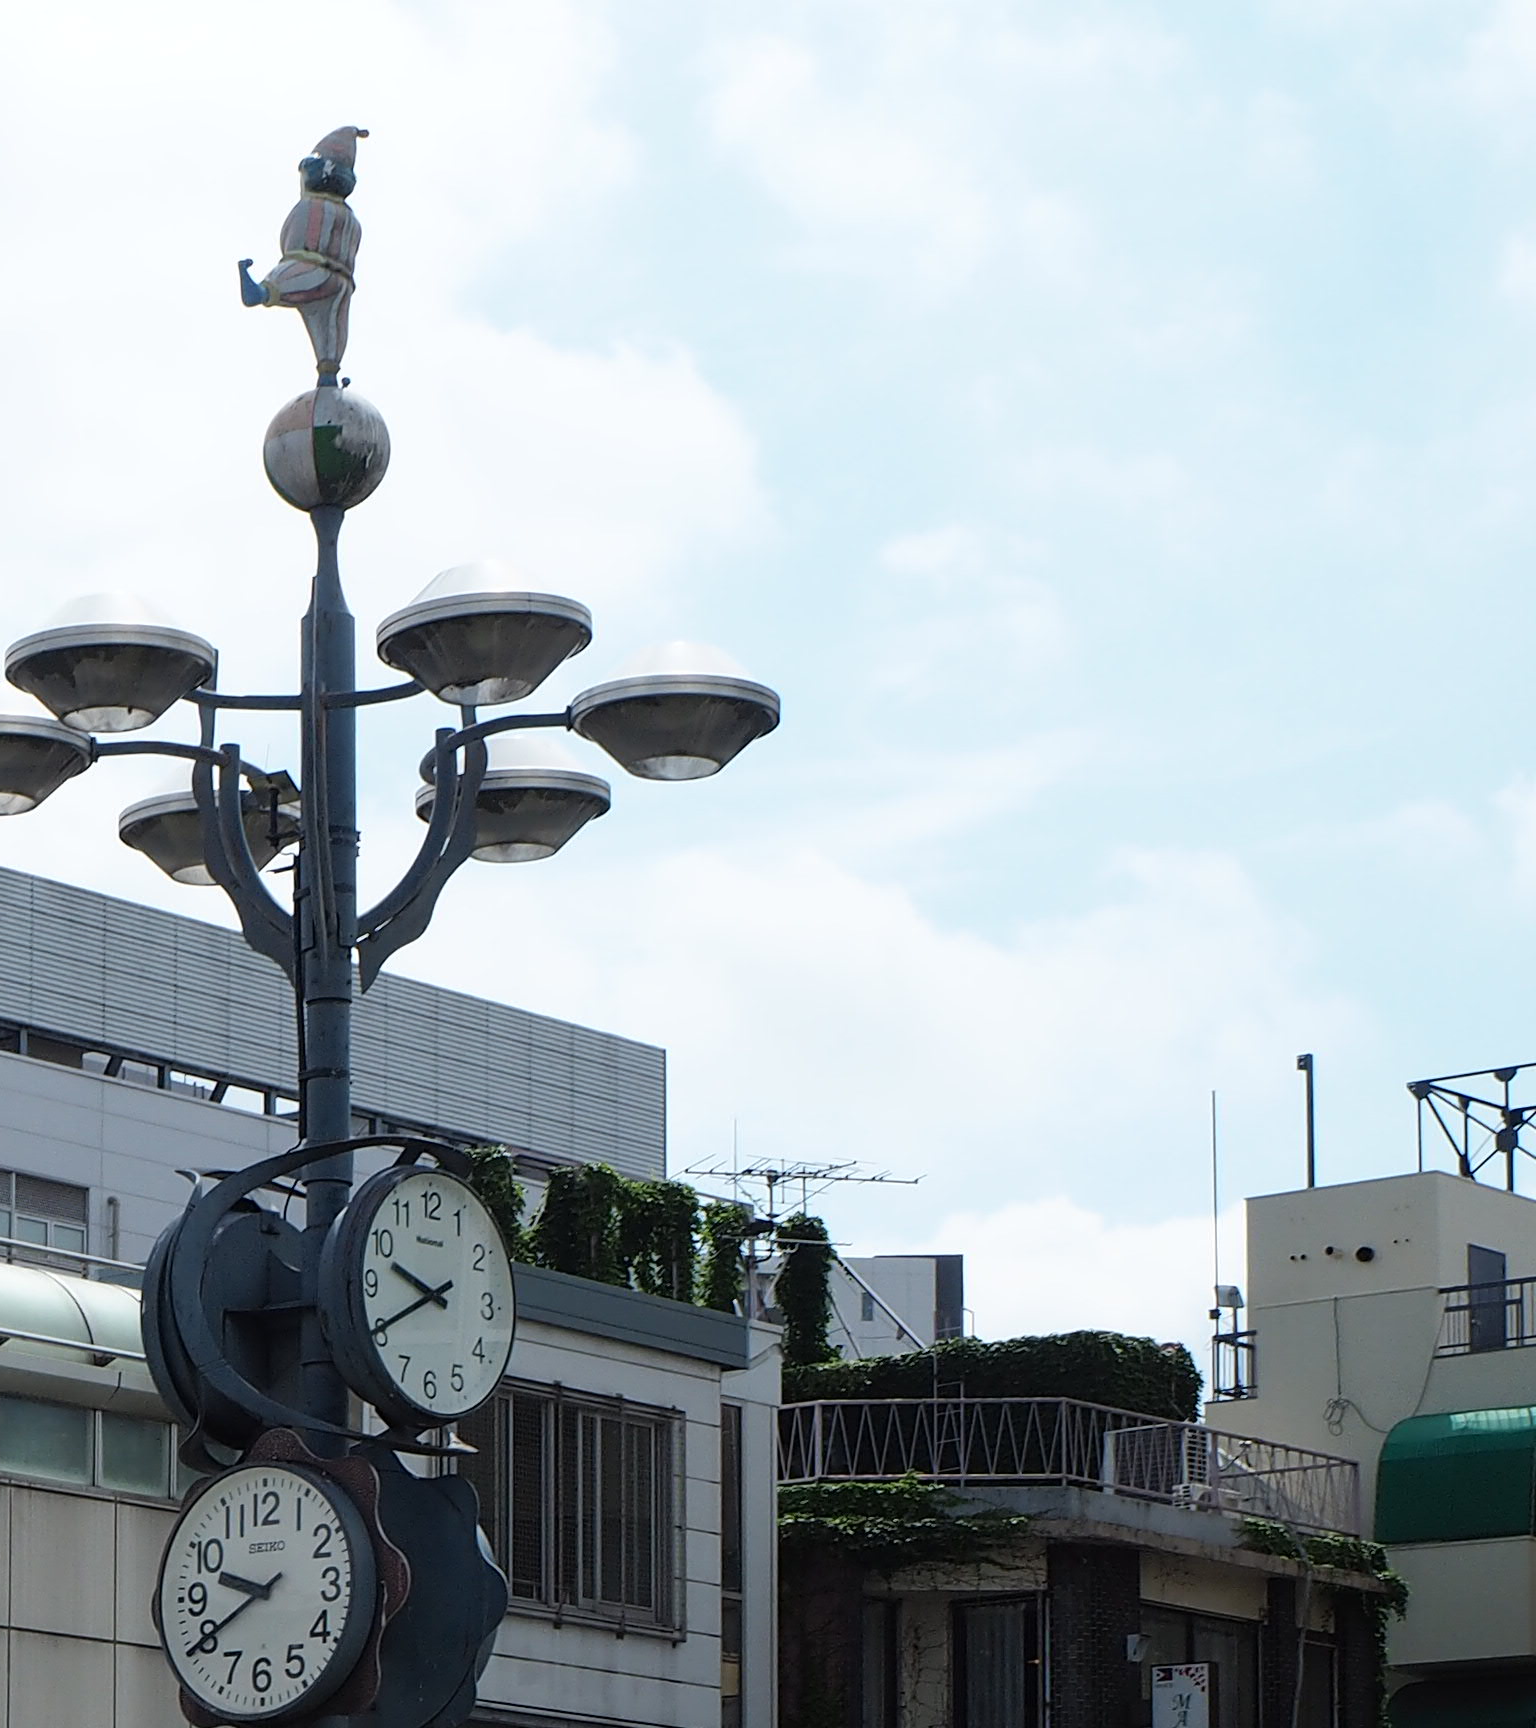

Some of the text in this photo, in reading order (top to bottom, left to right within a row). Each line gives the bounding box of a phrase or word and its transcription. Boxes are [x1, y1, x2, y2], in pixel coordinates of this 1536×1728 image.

[392, 1198, 409, 1228] 11
[420, 1190, 441, 1221] 12
[453, 1209, 461, 1237] 1
[371, 1228, 393, 1258] 10
[416, 1236, 444, 1248] National
[473, 1243, 485, 1272] 2
[364, 1269, 378, 1298] 9
[481, 1292, 494, 1321] 3
[375, 1318, 388, 1347] 8
[472, 1337, 485, 1364] 4
[398, 1354, 411, 1383] 7
[450, 1363, 464, 1392] 5
[423, 1370, 436, 1399] 6
[225, 1504, 244, 1540] 11
[253, 1490, 281, 1528] 12
[248, 1540, 286, 1554] SEIKO
[313, 1523, 332, 1559] 2
[197, 1538, 224, 1575] 10
[321, 1566, 341, 1602] 3
[187, 1582, 207, 1617] 9
[199, 1619, 218, 1654] 8
[309, 1609, 332, 1644] 4
[223, 1651, 244, 1685] 7
[252, 1657, 272, 1693] 6
[285, 1643, 305, 1679] 5
